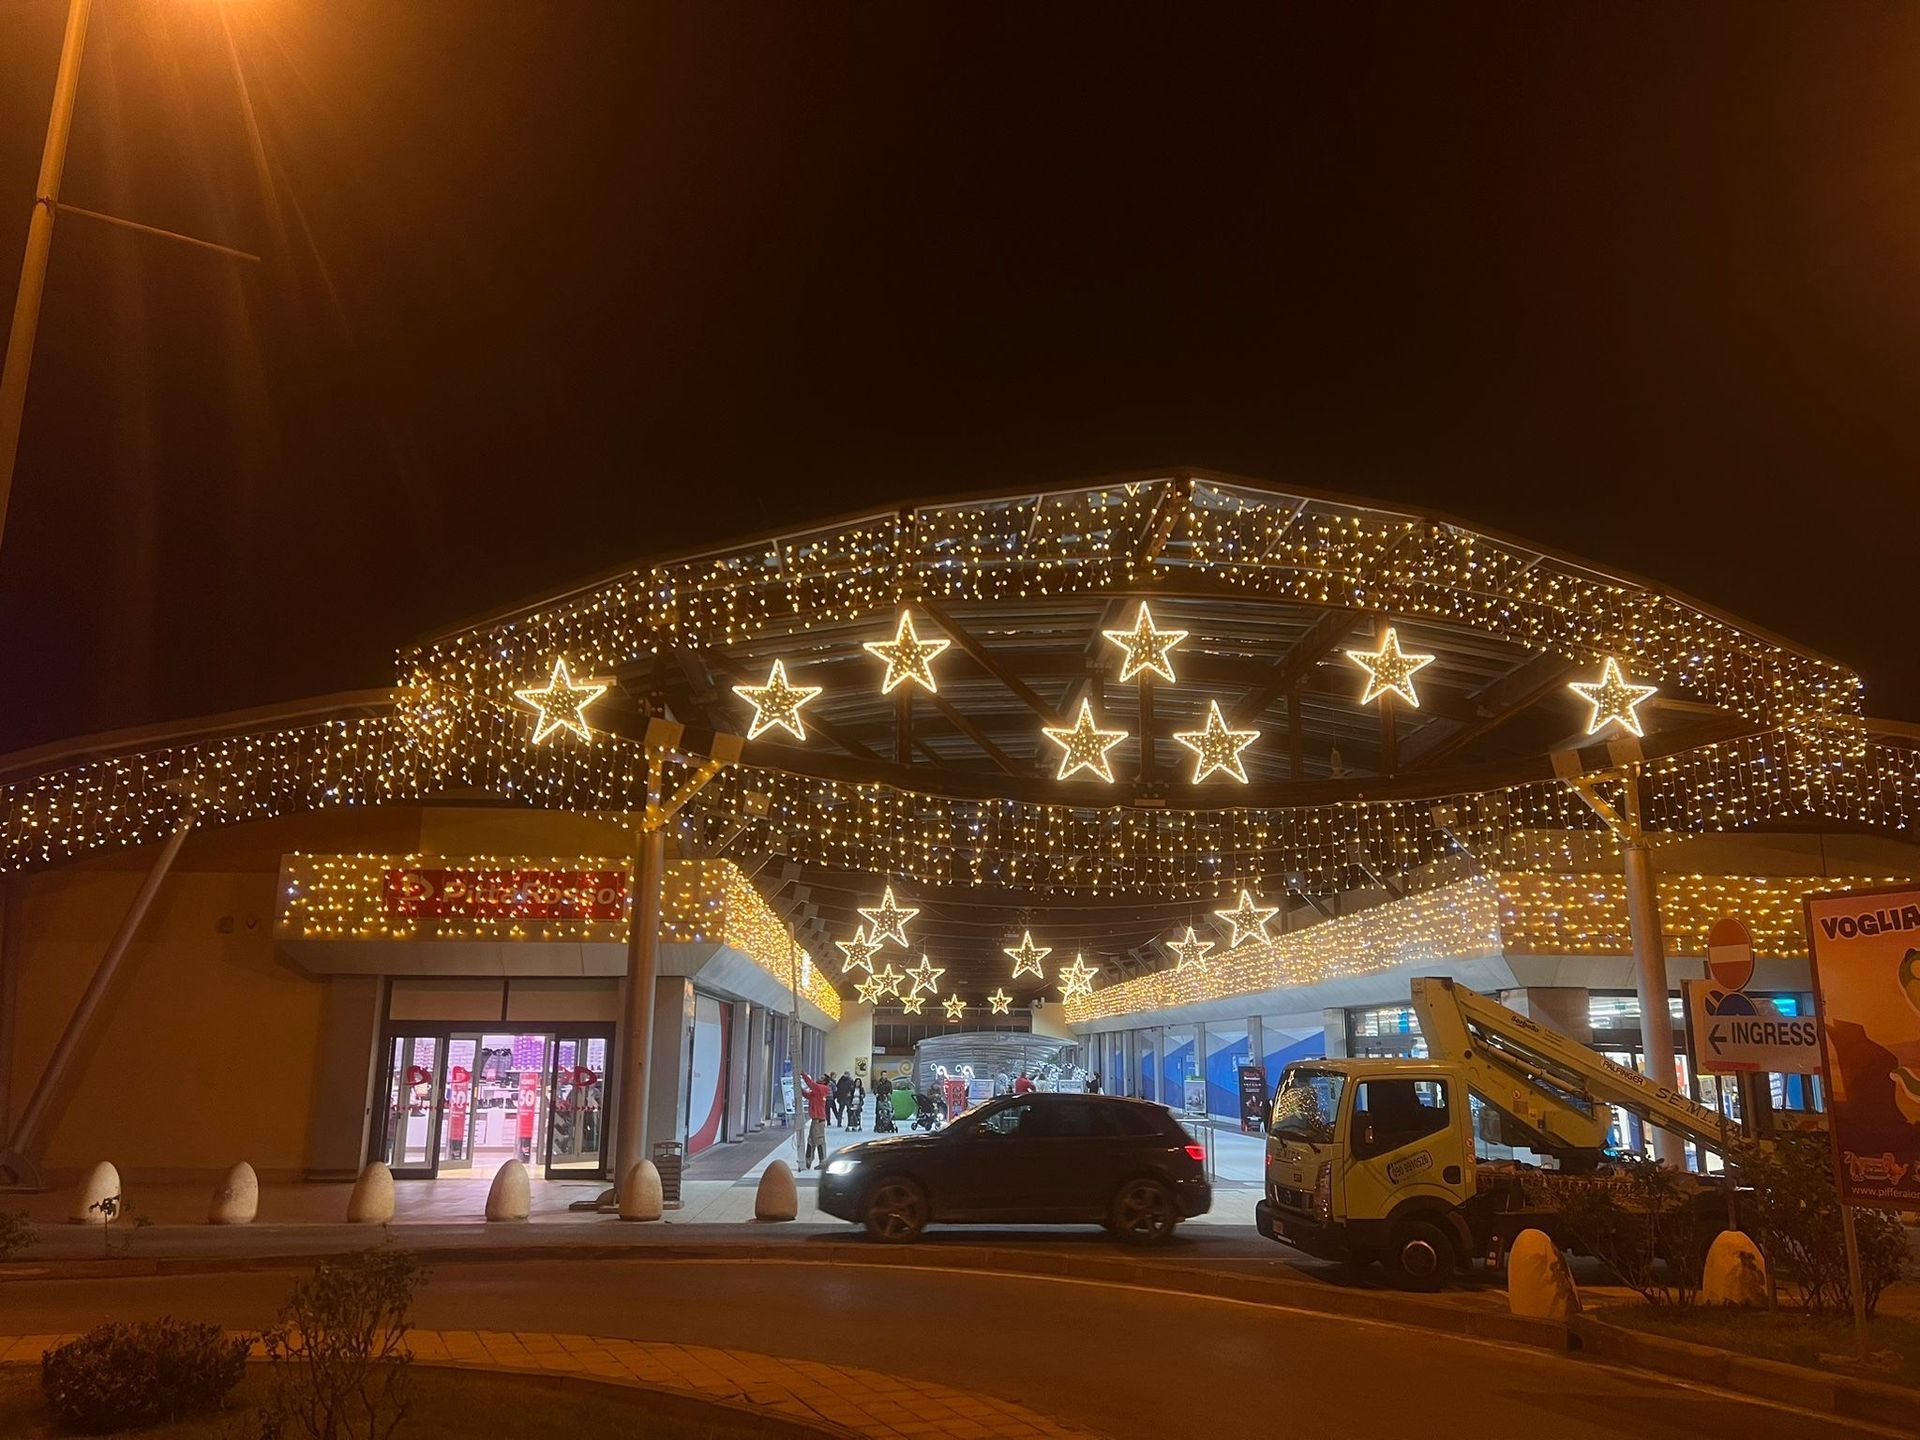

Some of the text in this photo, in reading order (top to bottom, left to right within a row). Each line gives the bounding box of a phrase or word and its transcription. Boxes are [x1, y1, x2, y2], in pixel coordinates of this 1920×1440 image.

[1731, 1022, 1818, 1046] INGRESS
[1602, 1060, 1645, 1087] PALFINGER
[518, 1089, 536, 1107] 50
